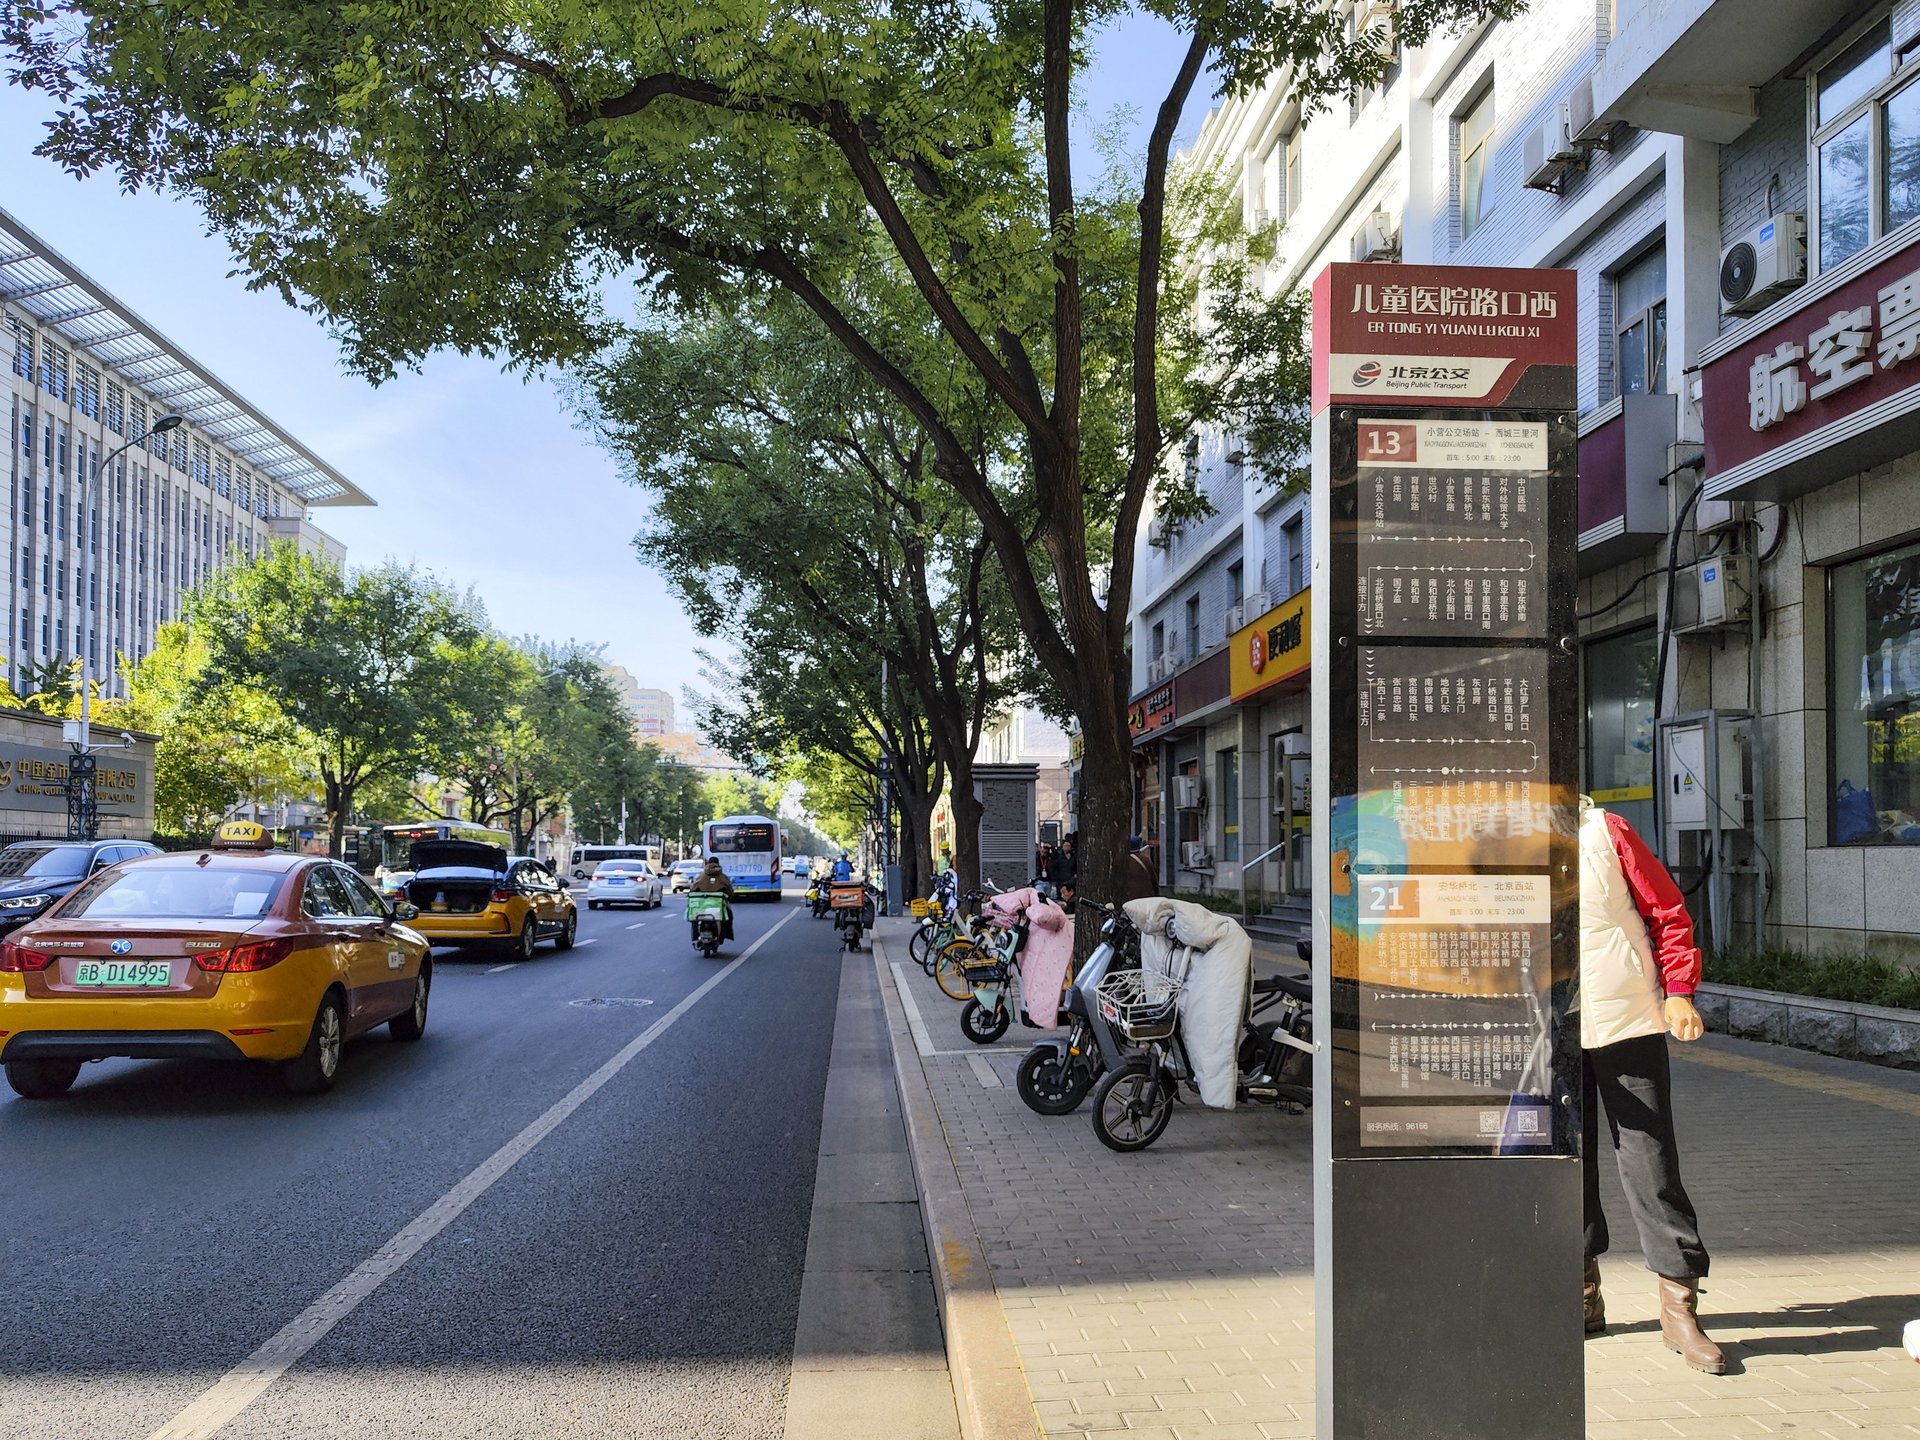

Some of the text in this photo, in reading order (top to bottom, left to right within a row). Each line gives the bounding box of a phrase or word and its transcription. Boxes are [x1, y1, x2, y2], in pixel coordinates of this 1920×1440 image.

[1350, 283, 1557, 319] 儿童医院路口西
[1367, 321, 1540, 338] ER TONG YI YUAN LU KOU XI
[1386, 380, 1467, 390] Beijing Public Transport
[1387, 366, 1470, 381] 北京公交
[1368, 430, 1401, 455] 13
[1427, 427, 1539, 439] 小营公交场站 西城三里河
[1375, 475, 1384, 528] 小营公交场站
[1428, 476, 1438, 503] 世纪村
[1446, 476, 1455, 512] 小营东路
[1464, 477, 1473, 521] 惠新东桥北
[1481, 477, 1491, 521] 惠新东桥南
[1499, 477, 1509, 530] 对外经贸大学
[1517, 477, 1527, 513] 中日医院
[1358, 576, 1367, 612] 连接下方
[1375, 577, 1384, 628] 北新桥路口北
[1464, 579, 1473, 620] 和平里南口
[1482, 579, 1491, 630] 和平里路口南
[1500, 579, 1509, 622] 和平里东街
[1517, 579, 1527, 622] 和平东桥南
[1360, 690, 1370, 727] 连接上方
[1376, 677, 1386, 722] 东四十二条
[1392, 677, 1402, 713] 张自忠路
[1408, 677, 1418, 722] 宽街路口东
[1424, 678, 1434, 713] 南锣鼓巷
[1440, 677, 1450, 713] 地安门东
[1456, 678, 1466, 714] 北海北门
[1472, 678, 1481, 705] 东官房
[1488, 678, 1498, 722] 厂桥路口东
[1503, 678, 1514, 731] 平安里路口南
[1519, 678, 1529, 731] 大红罗厂西口
[226, 827, 256, 837] TAXI
[1370, 886, 1404, 911] 21
[1494, 881, 1534, 891] 北京西站
[1439, 932, 1449, 968] 牡丹园东
[1449, 932, 1459, 968] 牡丹园西
[1460, 931, 1470, 985] 塔院小区南门
[1490, 931, 1500, 968] 明光桥南
[1501, 931, 1511, 968] 文慧桥南
[1521, 931, 1531, 968] 西直门南
[1389, 1035, 1399, 1073] 北京西站
[1420, 1035, 1430, 1081] 军事博物馆
[1430, 1035, 1440, 1072] 木樨地西
[1440, 1035, 1450, 1072] 木樨地北
[1451, 1035, 1460, 1081] 西城三里河
[1461, 1035, 1471, 1080] 三里河东口
[1492, 1035, 1502, 1080] 月坛体育场
[1502, 1034, 1512, 1071] 阜成门南
[1512, 1034, 1522, 1071] 阜成门北
